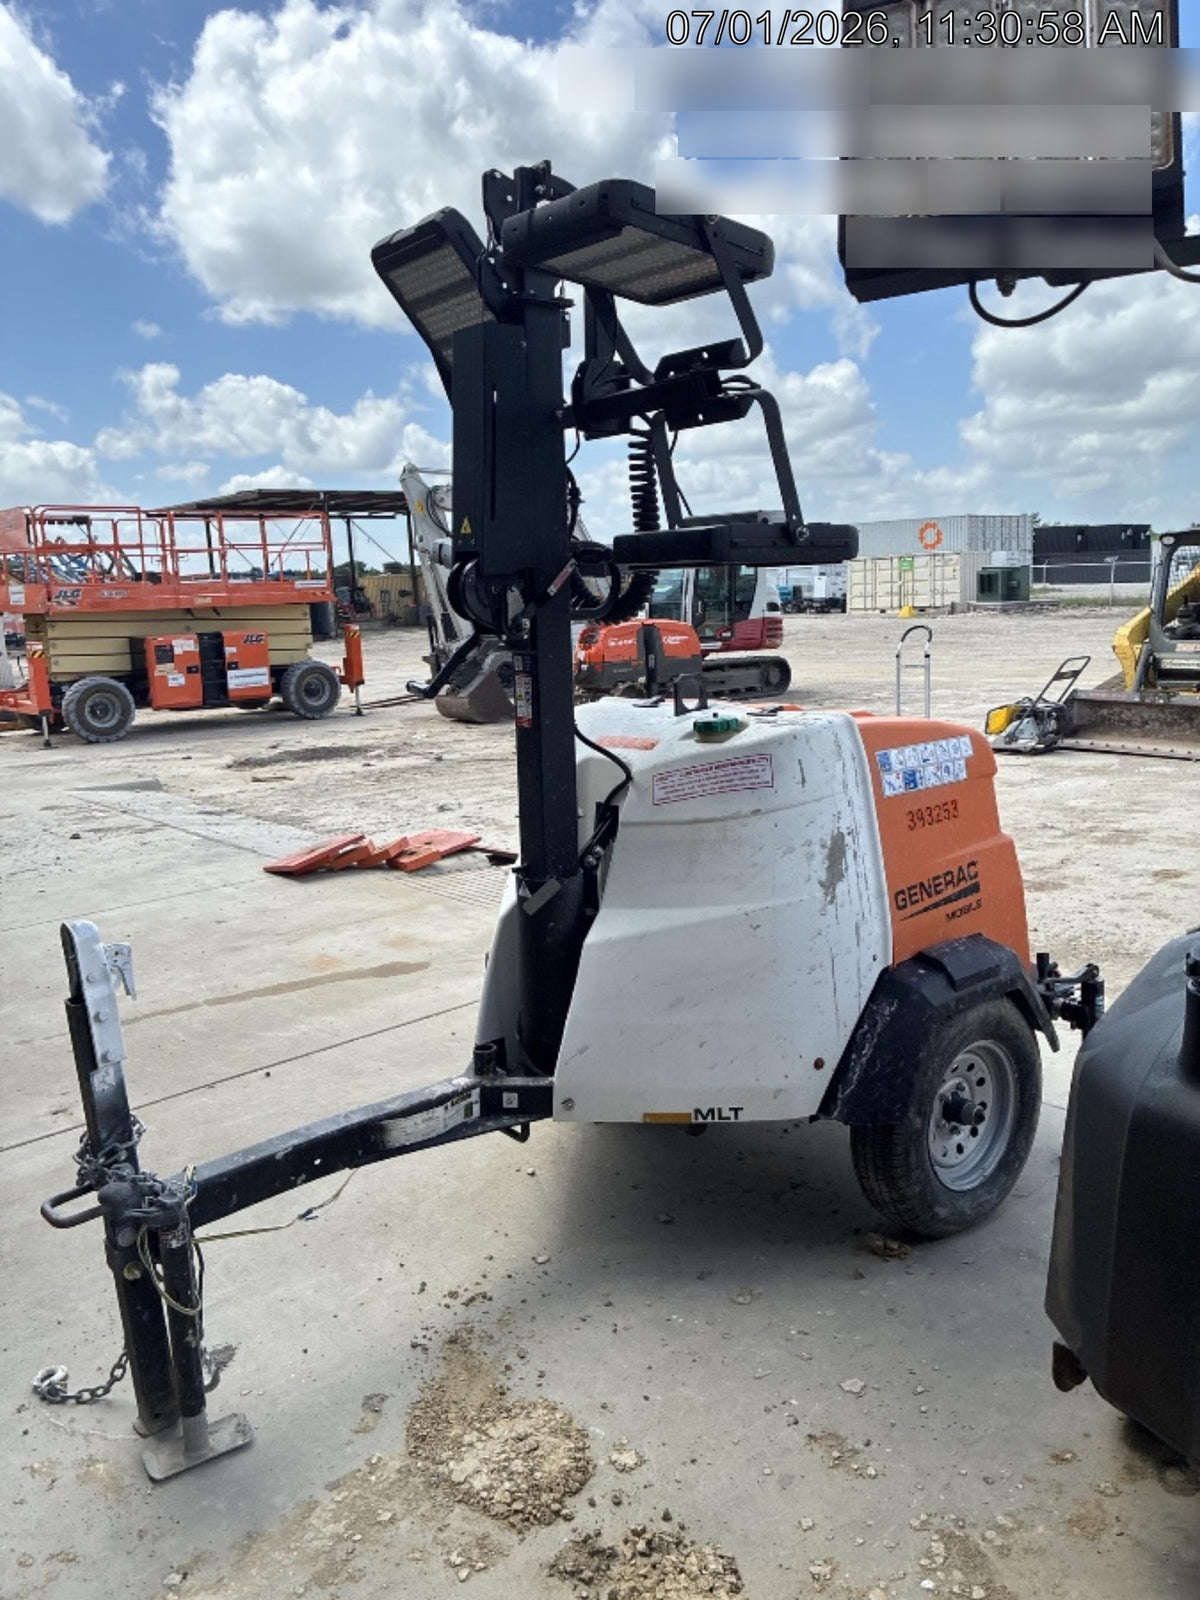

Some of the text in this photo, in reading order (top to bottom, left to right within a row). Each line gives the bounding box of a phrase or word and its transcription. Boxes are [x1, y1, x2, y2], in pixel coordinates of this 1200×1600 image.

[55, 587, 82, 599] JLG
[906, 800, 959, 831] 393253
[894, 860, 979, 911] GENERAC
[693, 1106, 744, 1121] MLT
